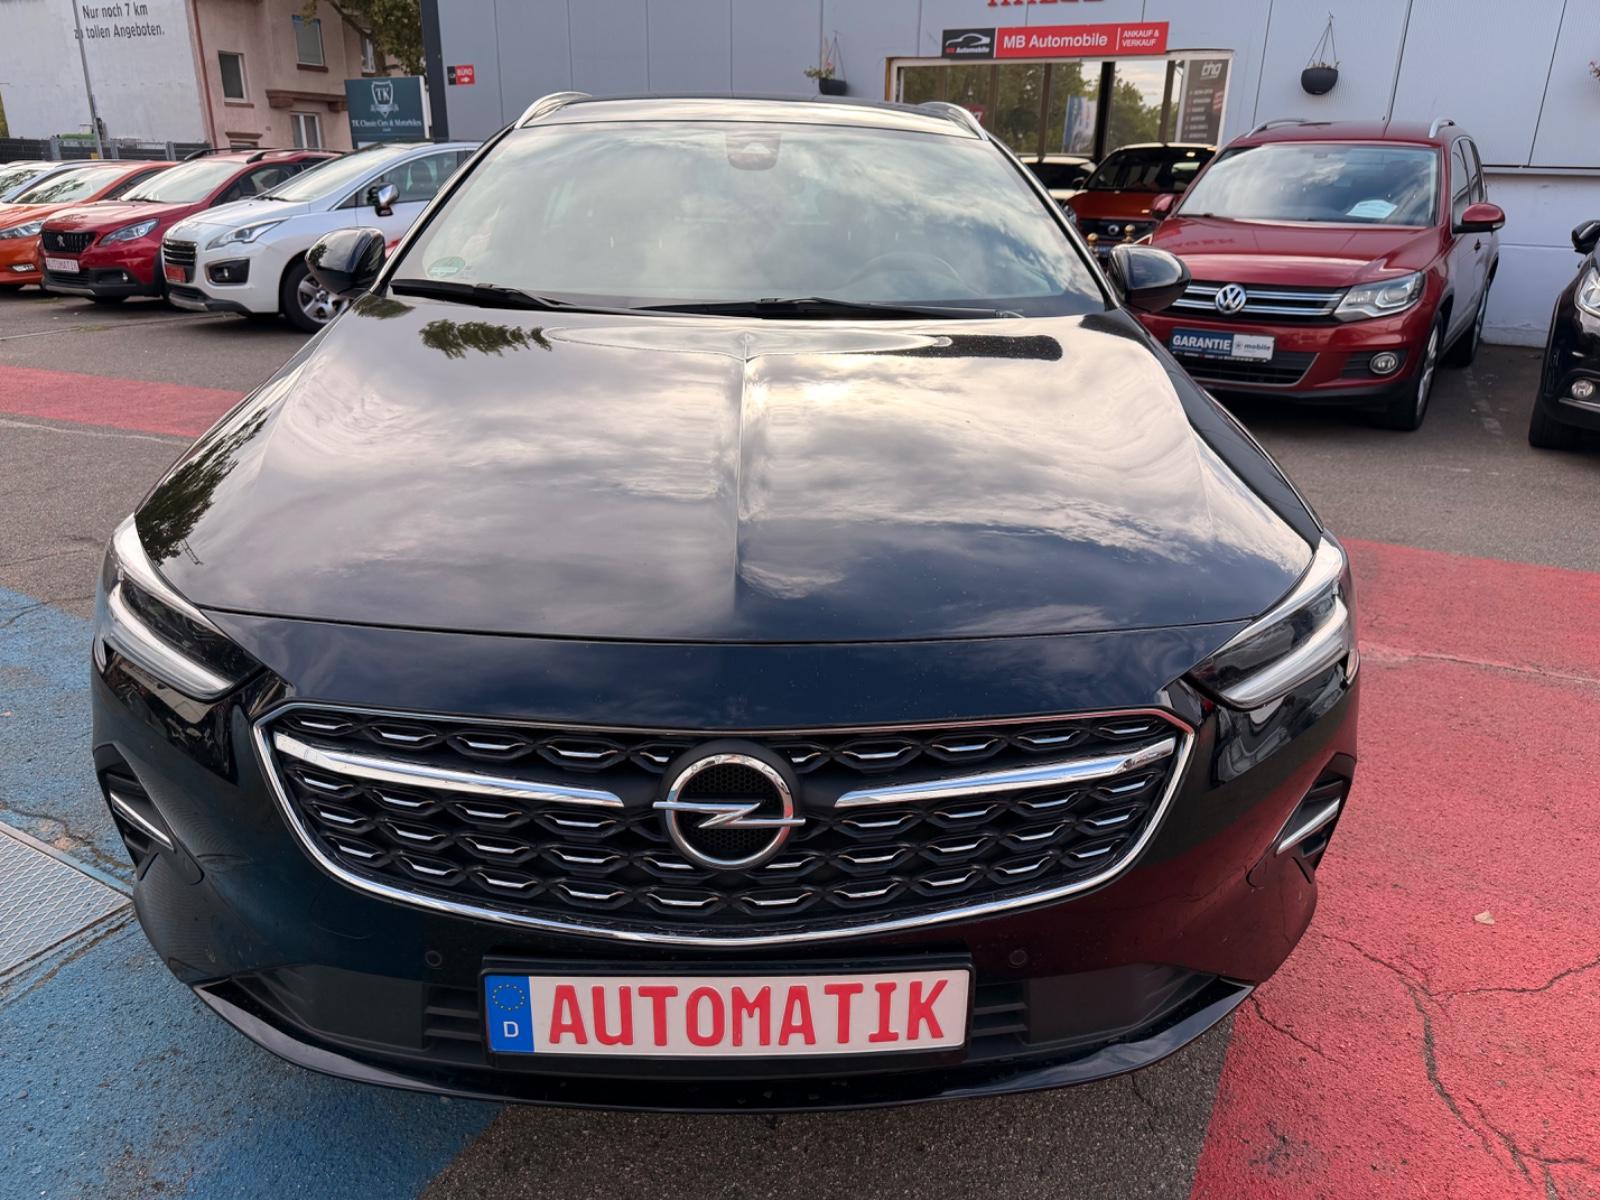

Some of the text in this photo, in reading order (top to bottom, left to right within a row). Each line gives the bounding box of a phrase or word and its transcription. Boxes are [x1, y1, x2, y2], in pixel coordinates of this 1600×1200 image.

[82, 2, 148, 19] Nur noch 7 km
[86, 24, 111, 39] tollen
[113, 22, 165, 38] Angeboten.
[1122, 30, 1153, 38] ANKAUF
[1003, 33, 1108, 48] MB Automobile
[1122, 38, 1156, 47] VERKAUF
[375, 87, 390, 101] TK
[1172, 335, 1231, 350] GARANTIE
[1244, 343, 1270, 352] mobile
[503, 979, 949, 1047] D AUTOMATIK
